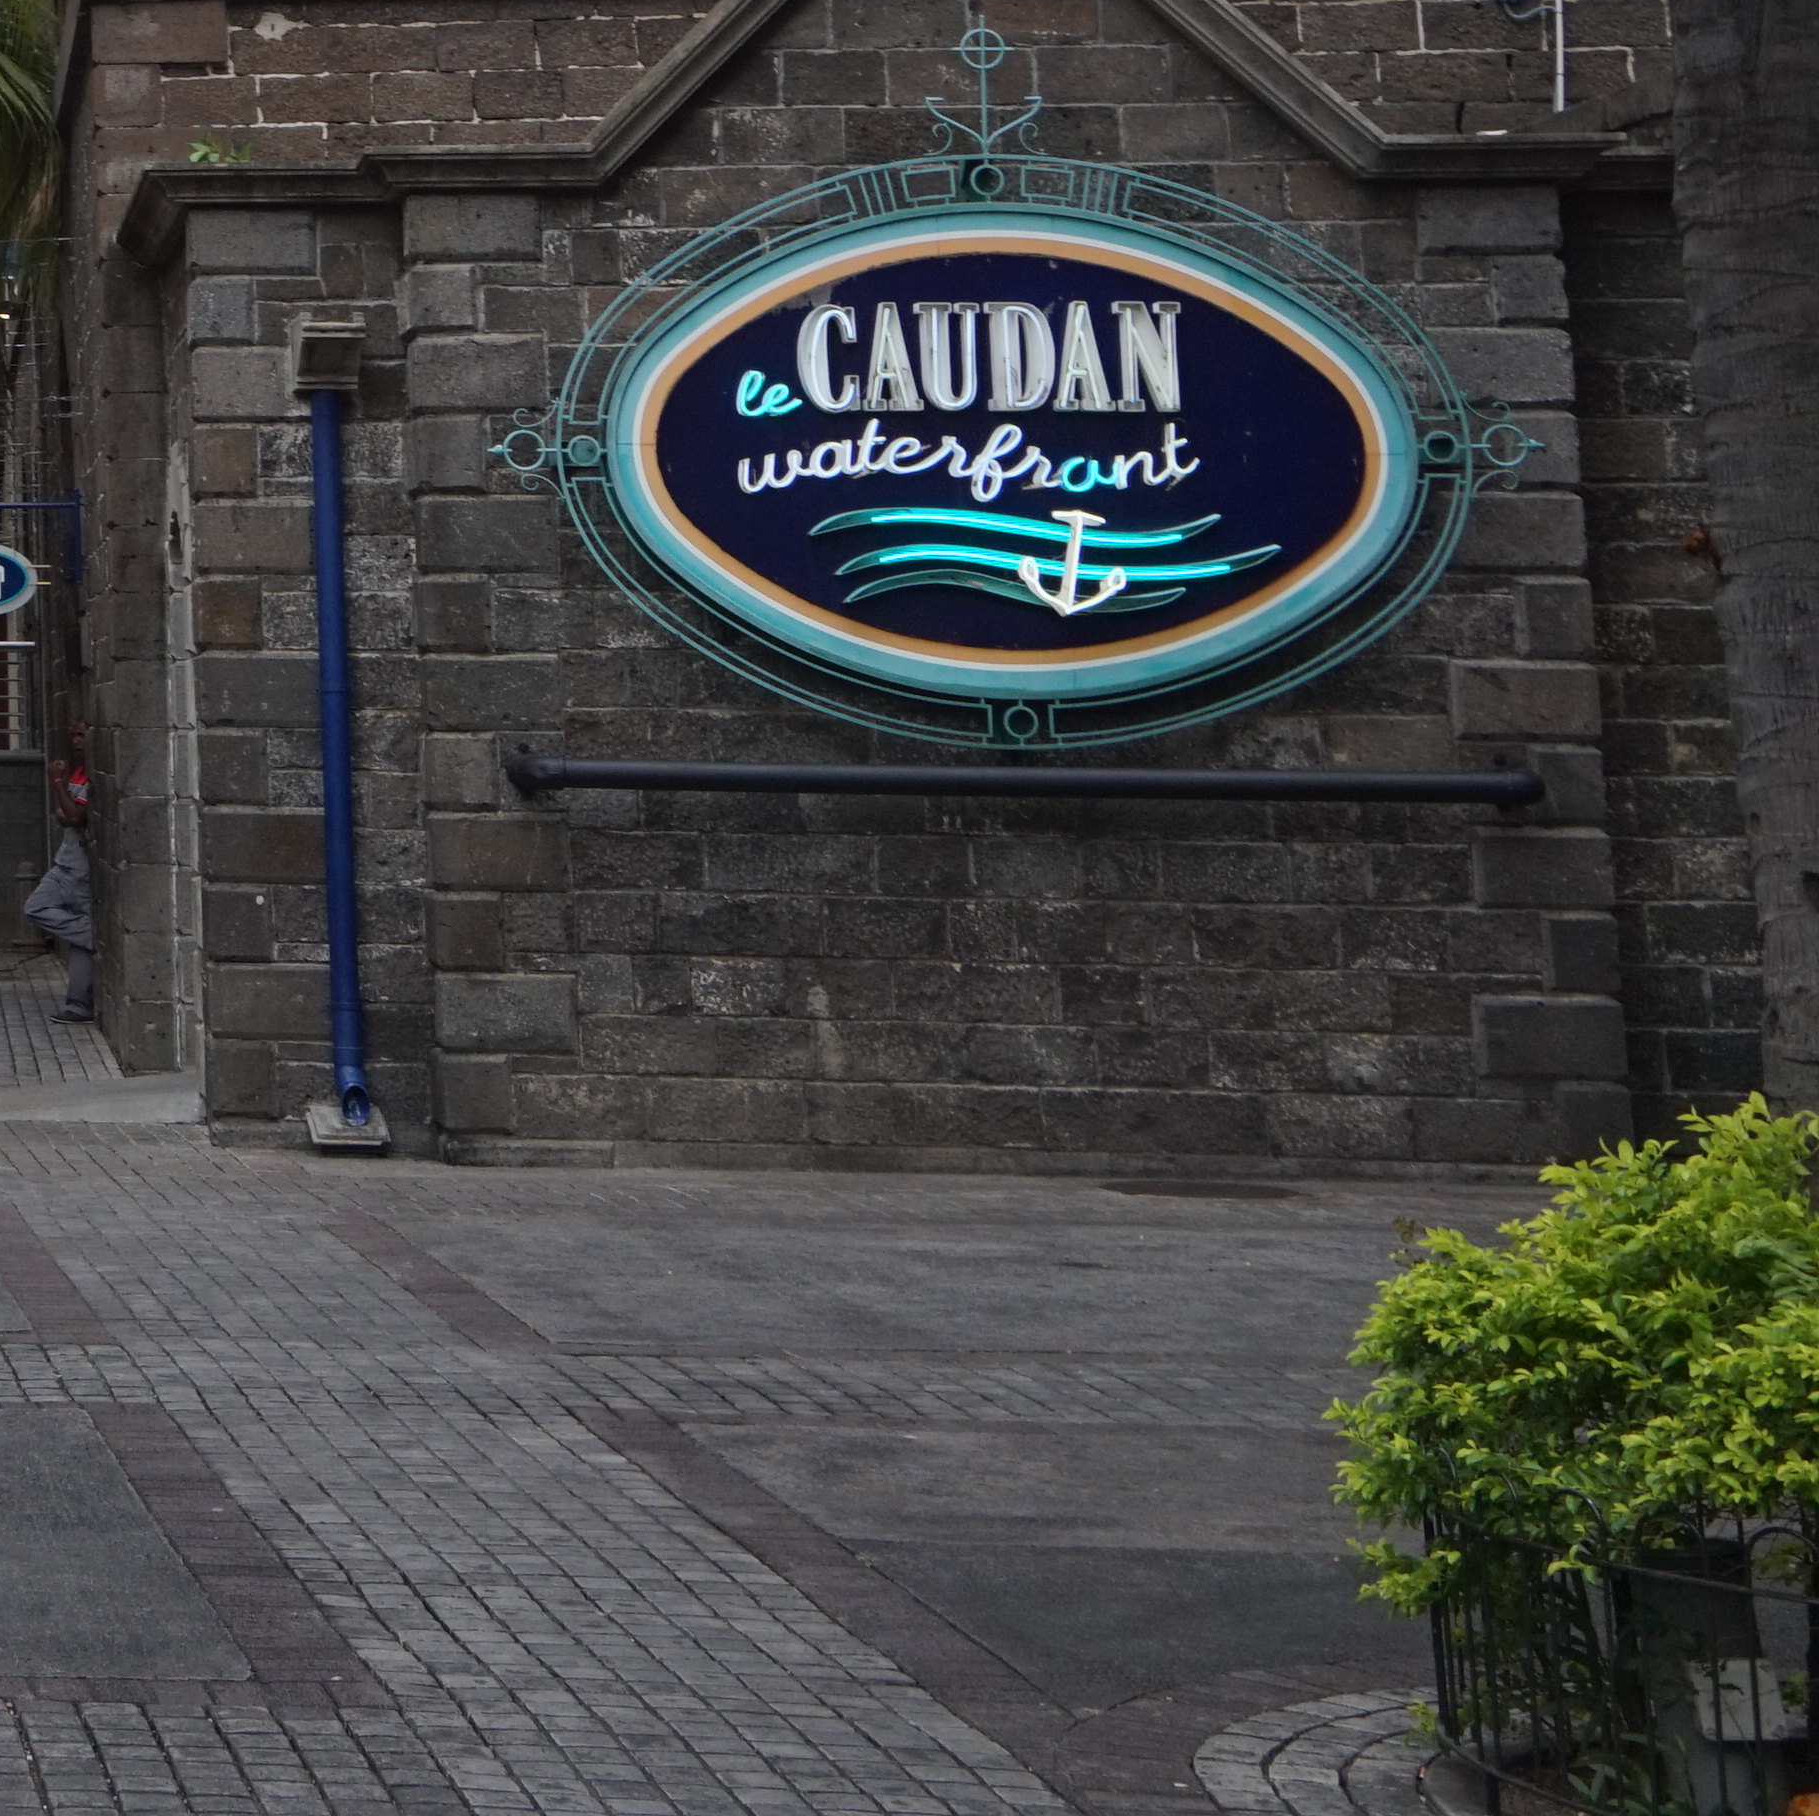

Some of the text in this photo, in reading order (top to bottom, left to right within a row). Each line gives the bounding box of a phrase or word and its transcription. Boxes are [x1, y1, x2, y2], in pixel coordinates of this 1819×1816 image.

[736, 300, 1182, 416] le CAUDAN
[737, 417, 1201, 502] waterfront
